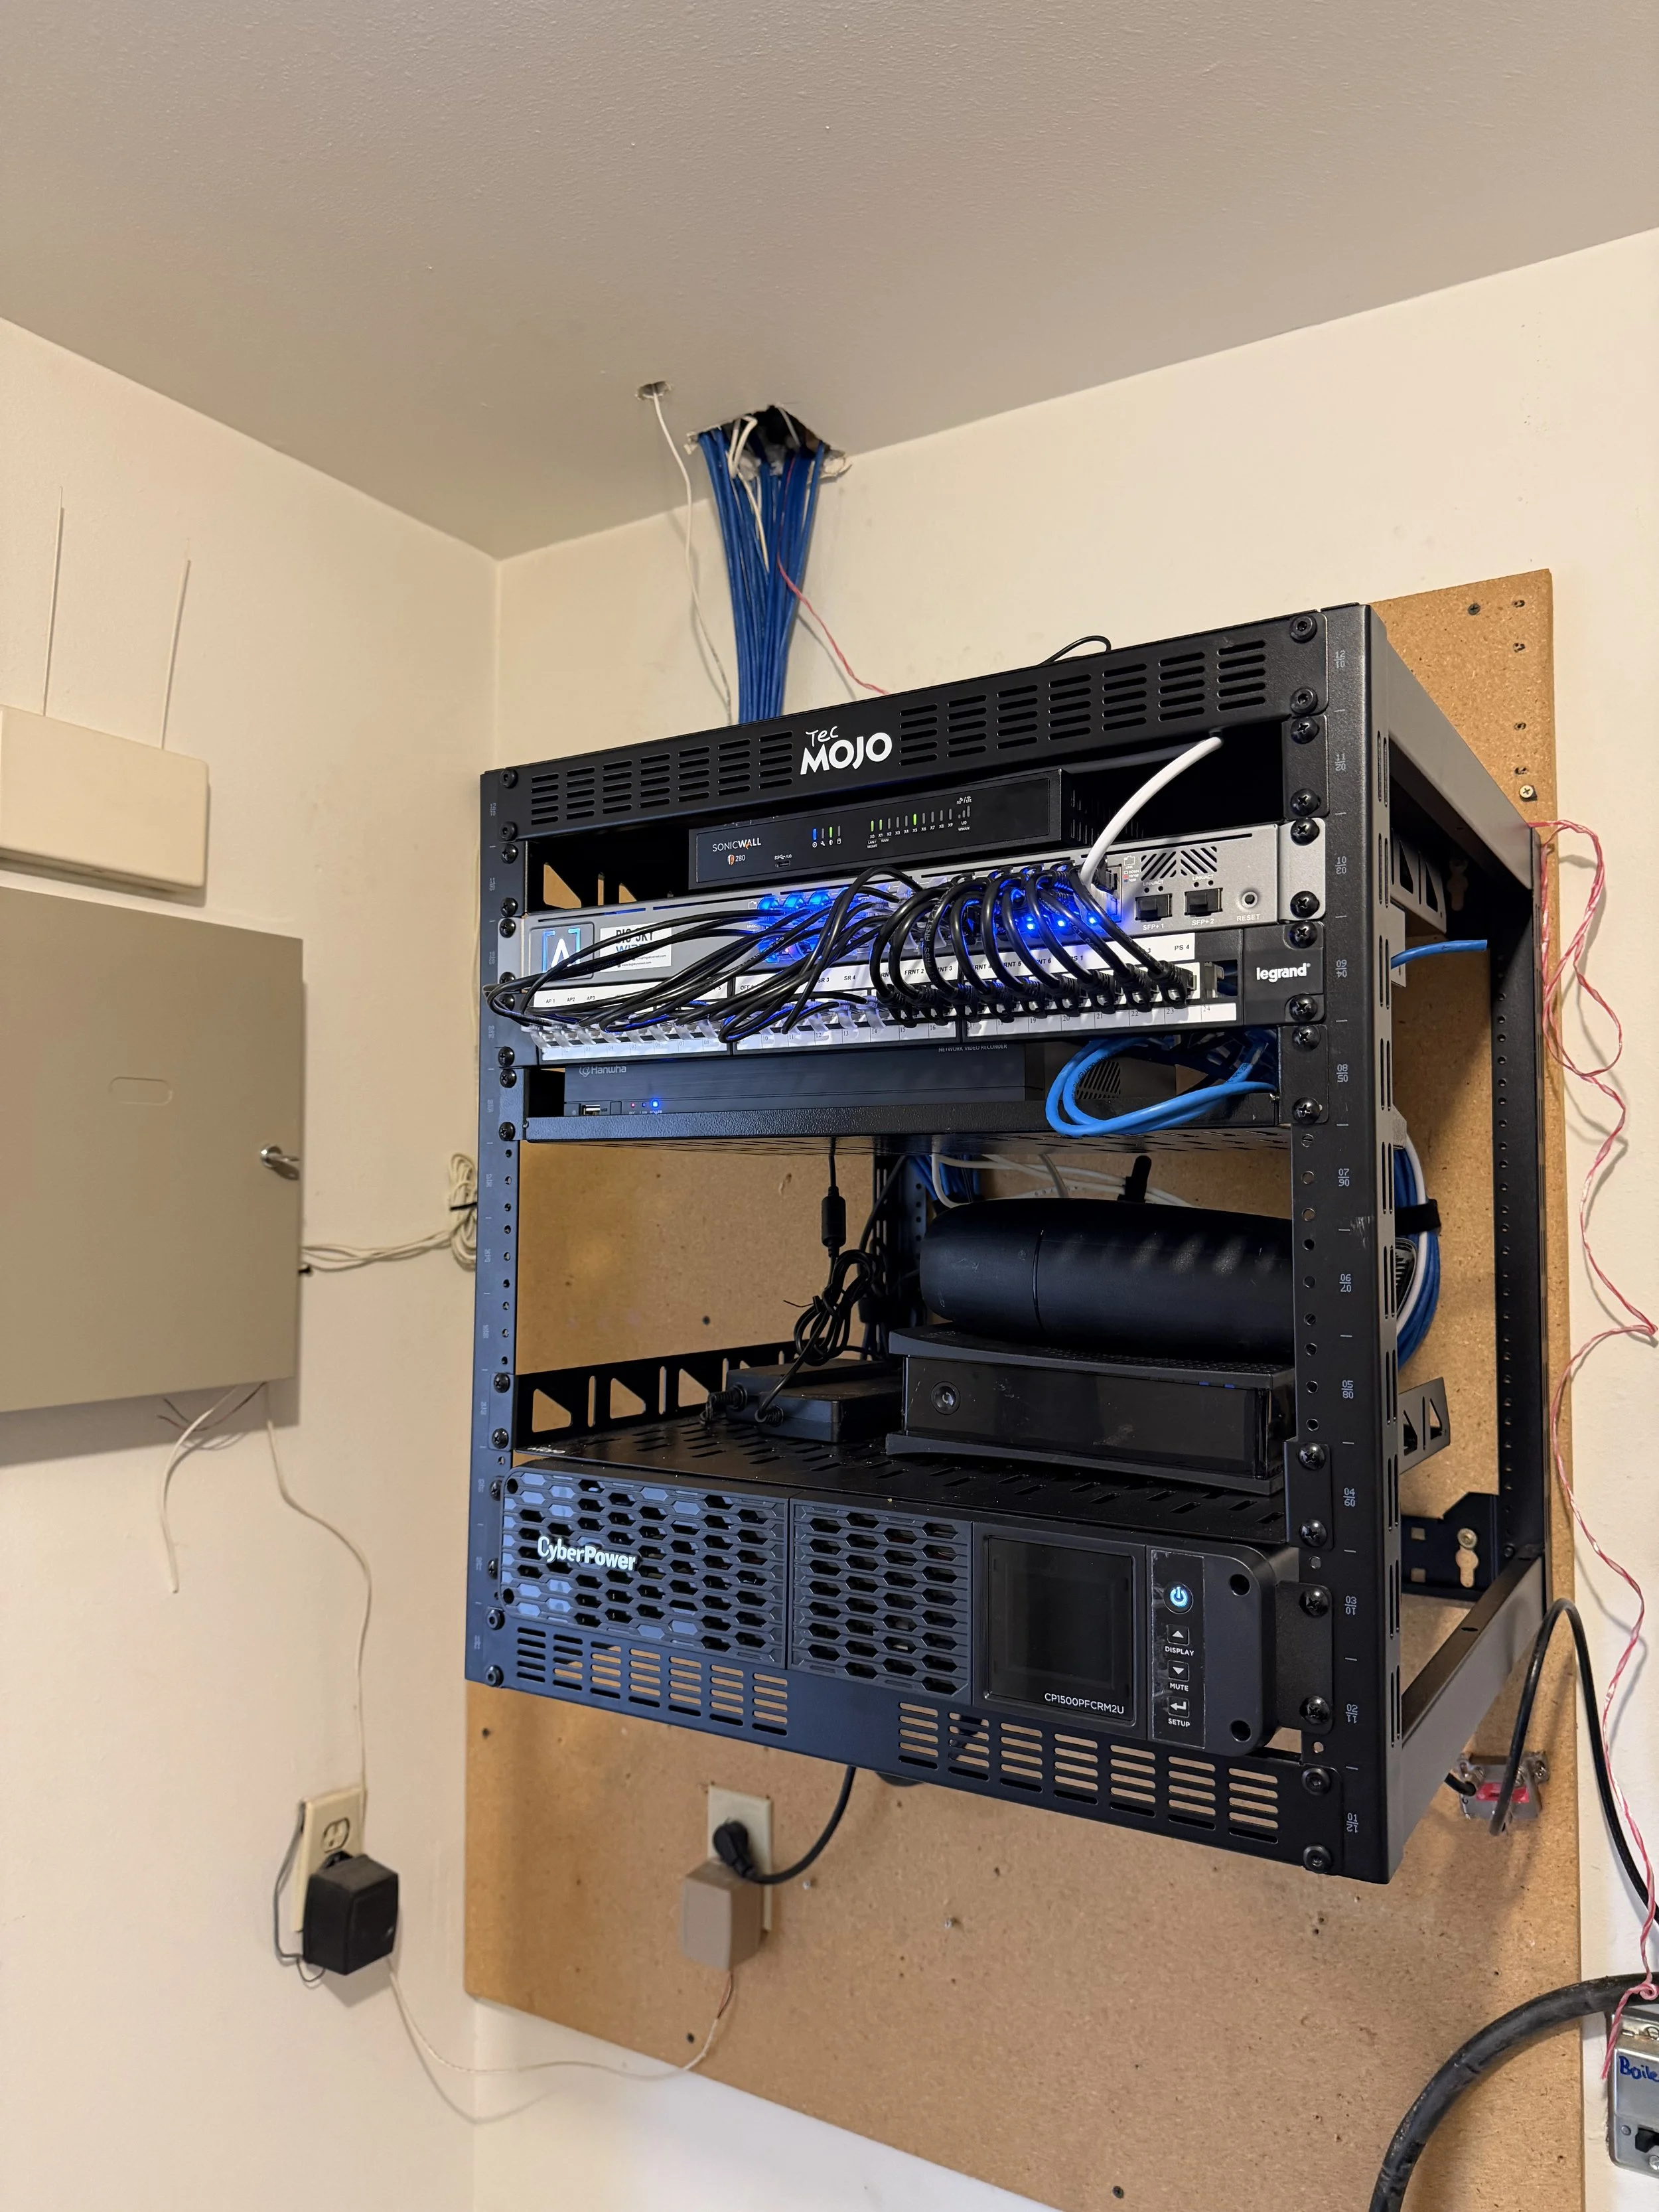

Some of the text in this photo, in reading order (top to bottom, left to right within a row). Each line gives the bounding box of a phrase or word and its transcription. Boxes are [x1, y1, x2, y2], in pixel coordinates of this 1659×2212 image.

[805, 725, 839, 747] Tec
[800, 732, 893, 775] MOJO
[712, 838, 761, 852] SONICWALL
[1336, 855, 1347, 864] 10
[1236, 913, 1260, 922] RESET
[1336, 959, 1348, 968] 09
[1256, 962, 1308, 983] legrand
[591, 1065, 627, 1074] Hanwha
[1337, 1063, 1348, 1072] 08
[1338, 1167, 1350, 1177] 07
[1340, 1273, 1352, 1282] 06
[1341, 1380, 1353, 1389] 05
[1344, 1487, 1355, 1497] 04
[538, 1536, 637, 1571] CyberPower
[1345, 1595, 1357, 1605] 03
[1165, 1645, 1194, 1657] DISPLAY
[1169, 1682, 1189, 1692] MUTE
[1044, 1692, 1125, 1714] CP1500PFCRM2U
[1346, 1703, 1358, 1714] 02
[1168, 1718, 1190, 1728] SETUP
[1346, 1812, 1358, 1823] 01
[1619, 2055, 1659, 2083] Boile
